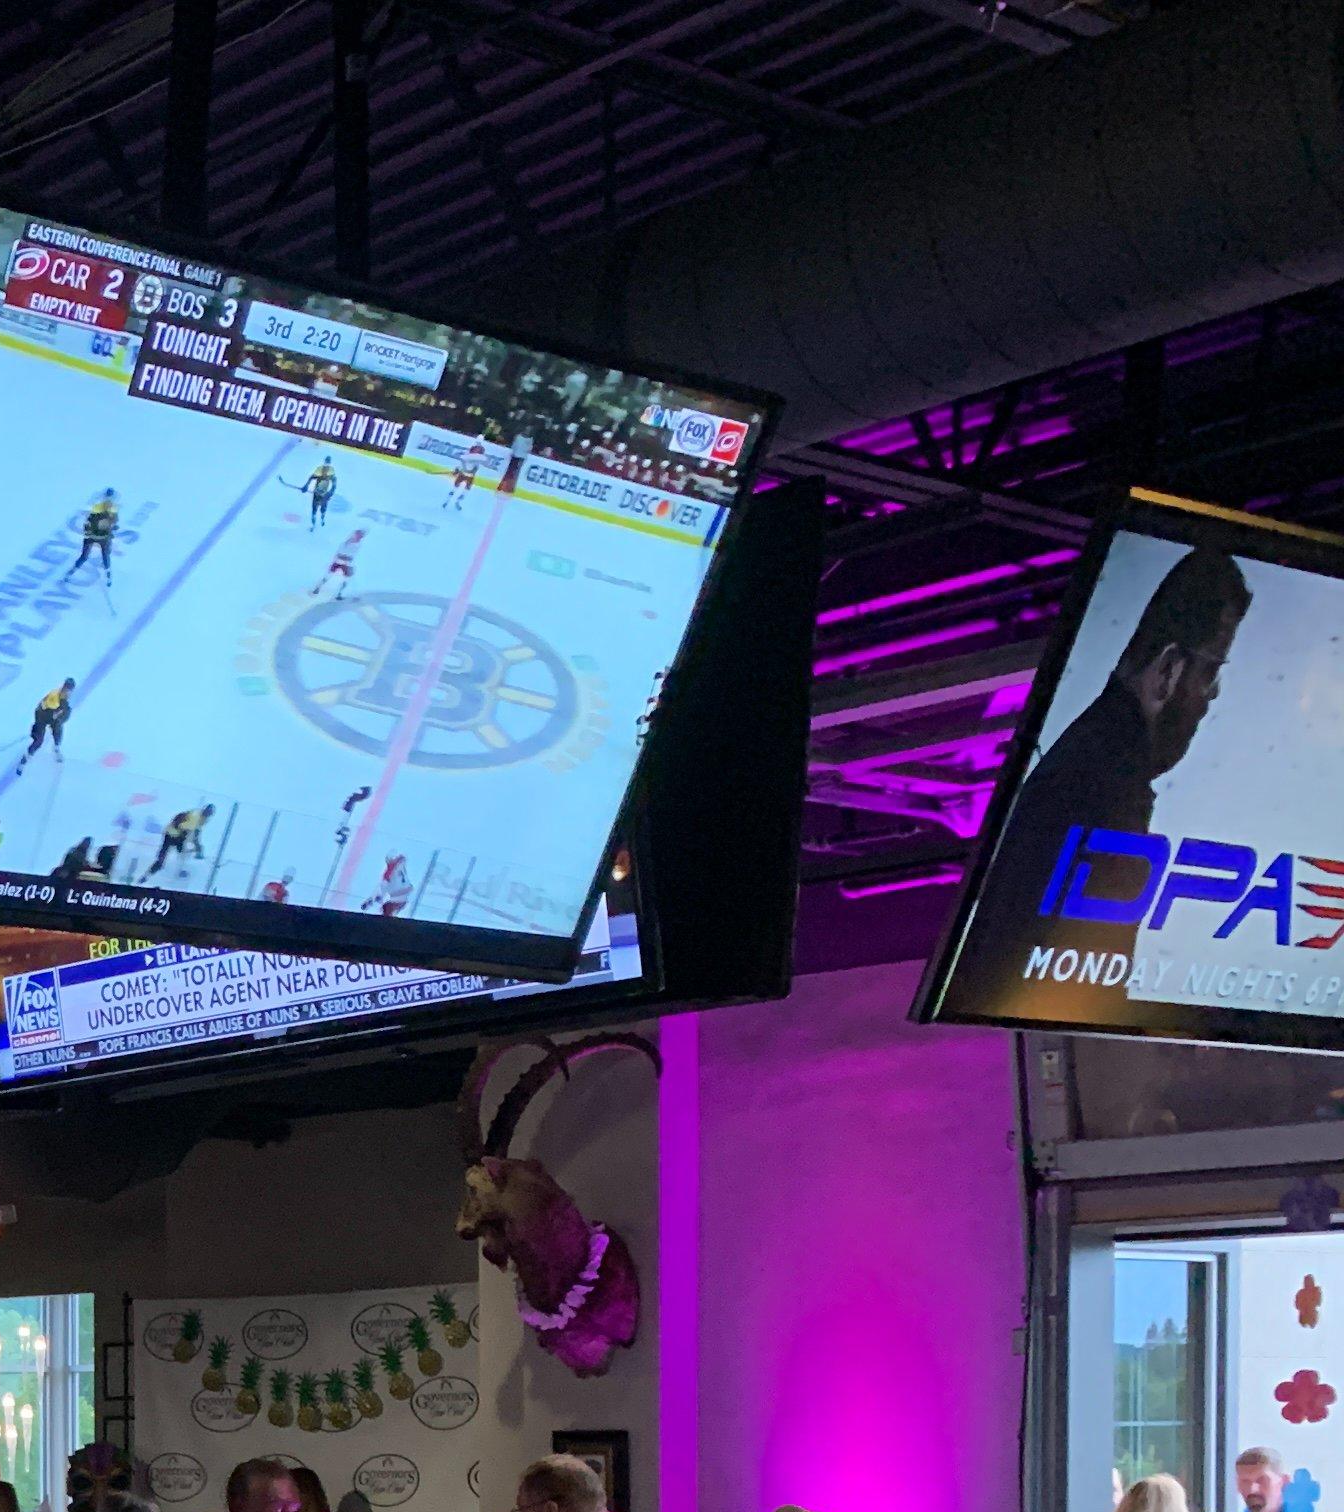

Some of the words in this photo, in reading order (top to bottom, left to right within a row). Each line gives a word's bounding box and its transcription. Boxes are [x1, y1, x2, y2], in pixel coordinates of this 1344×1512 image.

[28, 223, 79, 251] EASTERN
[78, 236, 151, 268] CONFERENCE
[151, 254, 180, 277] FINAL
[184, 264, 214, 284] GAME
[49, 257, 91, 291] CAR
[102, 268, 125, 300] 2
[29, 292, 76, 318] EMPTY
[76, 304, 102, 324] NET
[166, 287, 207, 319] BOS
[218, 298, 238, 328] 3
[151, 320, 232, 367] TONIGHT.
[264, 316, 292, 340] 3rd
[302, 325, 342, 352] 2:20
[137, 363, 214, 406] FINDING
[216, 380, 266, 423] THEM,
[271, 395, 346, 437] OPENING
[346, 411, 367, 443] IN
[369, 417, 404, 451] THE
[526, 464, 612, 503] GATORADE
[23, 884, 55, 902] (1-0)
[67, 888, 79, 904] L:
[81, 890, 138, 913] Quintana
[139, 897, 171, 916] (4-2)
[89, 938, 120, 960] FOR
[155, 946, 177, 966] ELI
[100, 972, 169, 1003] COMEY:
[173, 954, 256, 987] "TOTALLY
[1022, 944, 1175, 992] MONDAY
[1180, 964, 1299, 1004] NIGHTS
[23, 986, 57, 1012] FOX
[87, 990, 205, 1031] UNDERCOVER
[209, 977, 271, 1008] AGENT
[277, 967, 330, 1000] NEAR
[13, 1031, 61, 1048] channel
[14, 1051, 44, 1068] OTHER
[46, 1046, 75, 1063] NUNS
[98, 1037, 126, 1053] POPE
[127, 1028, 171, 1047] FRANCIS
[174, 1024, 206, 1041] CALLS
[208, 1015, 244, 1034] ABUSE
[246, 1013, 263, 1029] OF
[265, 1006, 300, 1025] NUNS
[321, 994, 376, 1015] SERIOUS,
[378, 986, 422, 1006] GRAVE
[15, 1009, 60, 1034] NEWS
[358, 1467, 415, 1486] Governors
